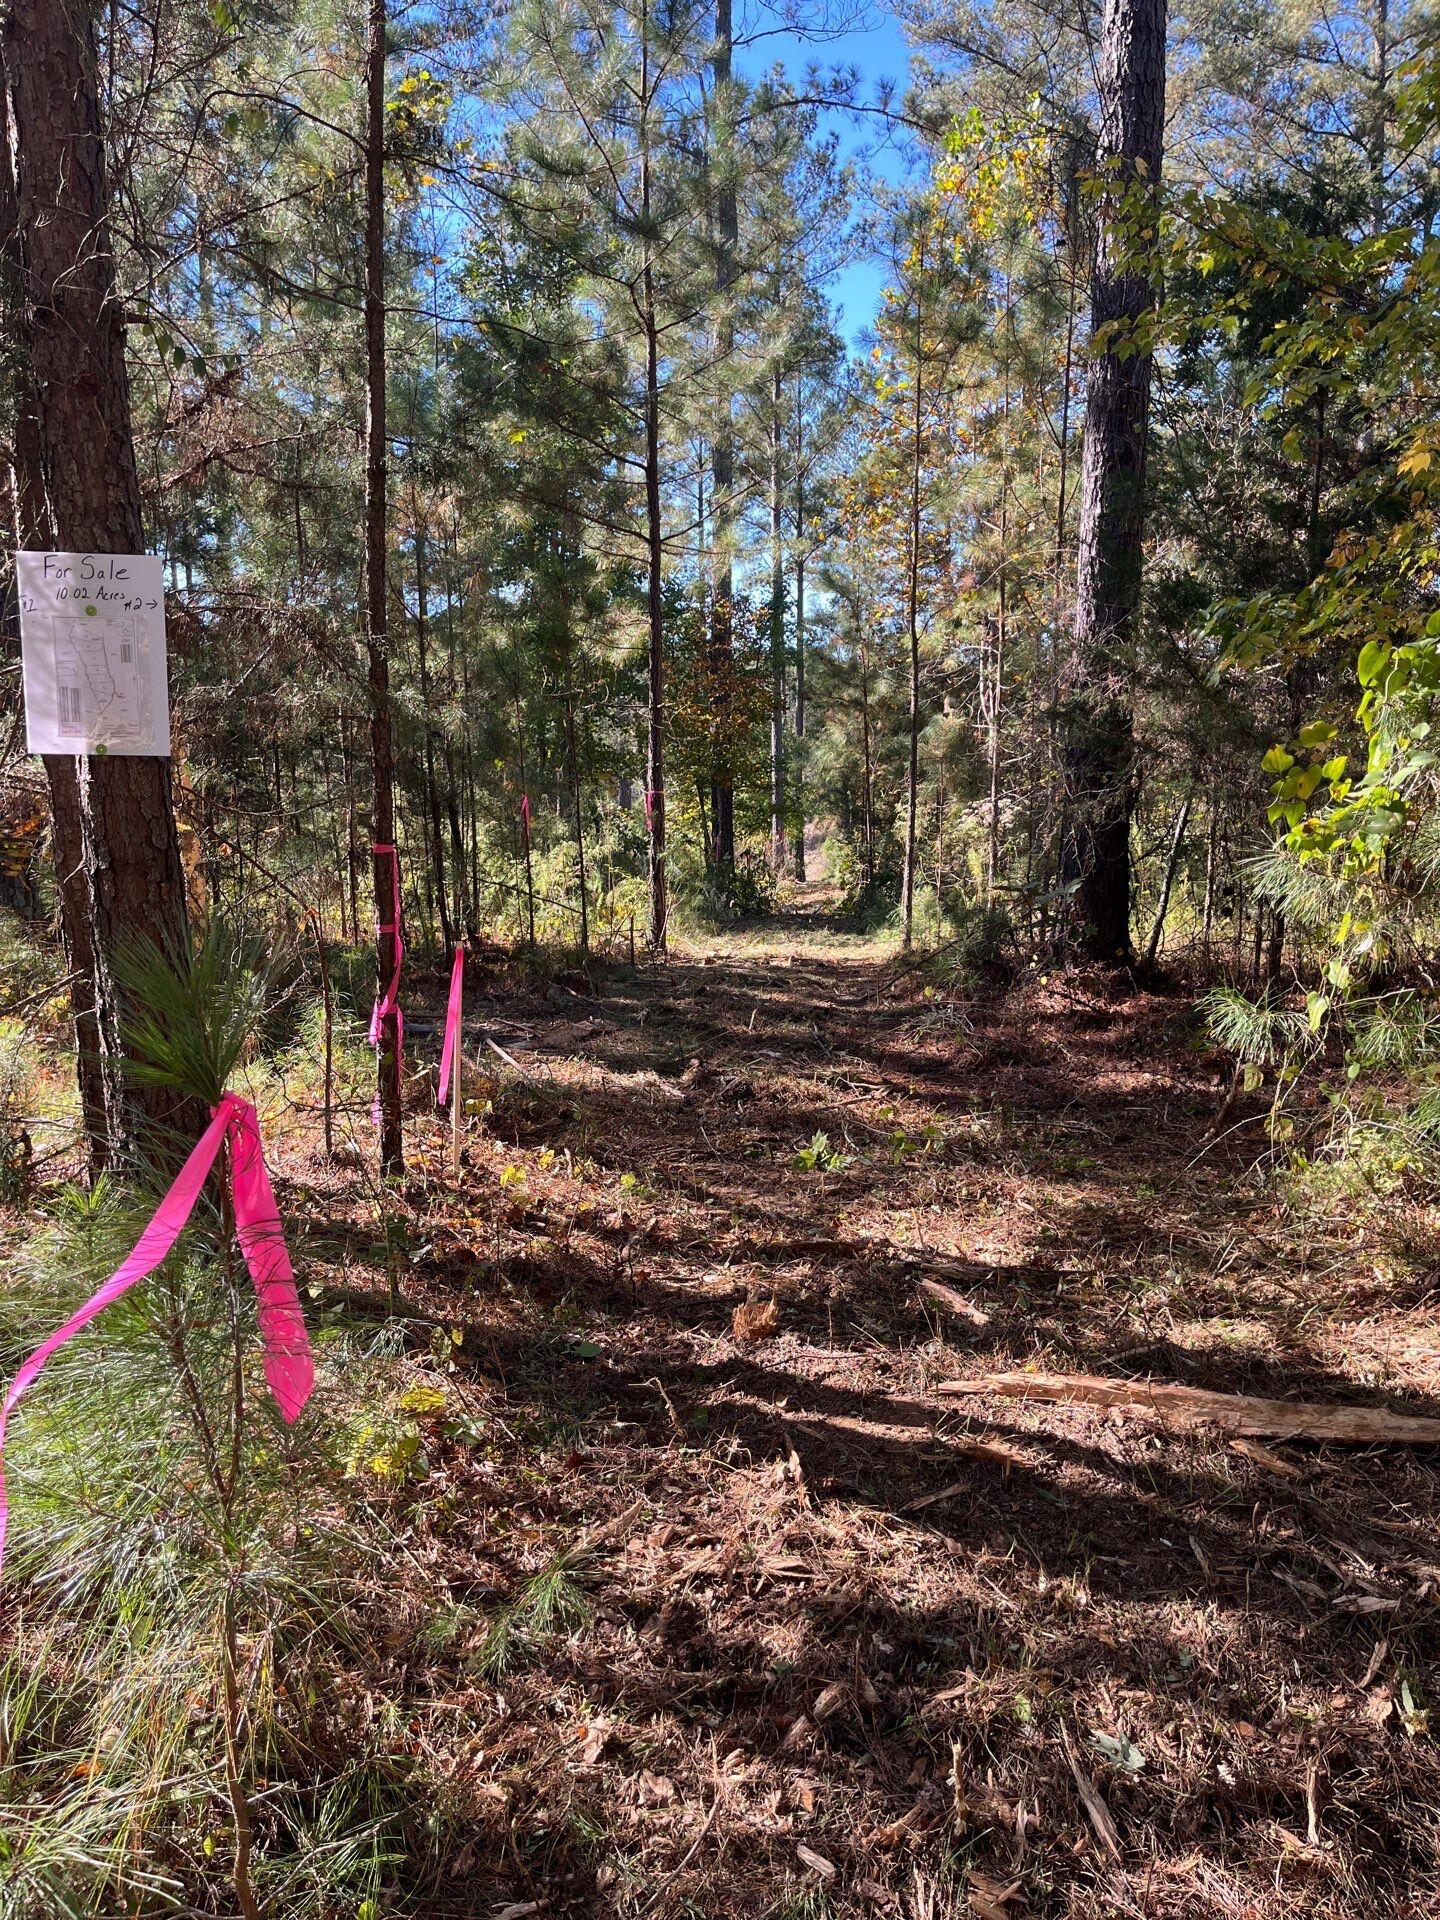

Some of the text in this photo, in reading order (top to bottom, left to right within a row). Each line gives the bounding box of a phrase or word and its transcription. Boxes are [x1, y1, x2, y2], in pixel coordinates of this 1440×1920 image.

[43, 555, 130, 580] For Sale
[56, 585, 126, 600] 10.02 Acres
[124, 597, 143, 611] #2
